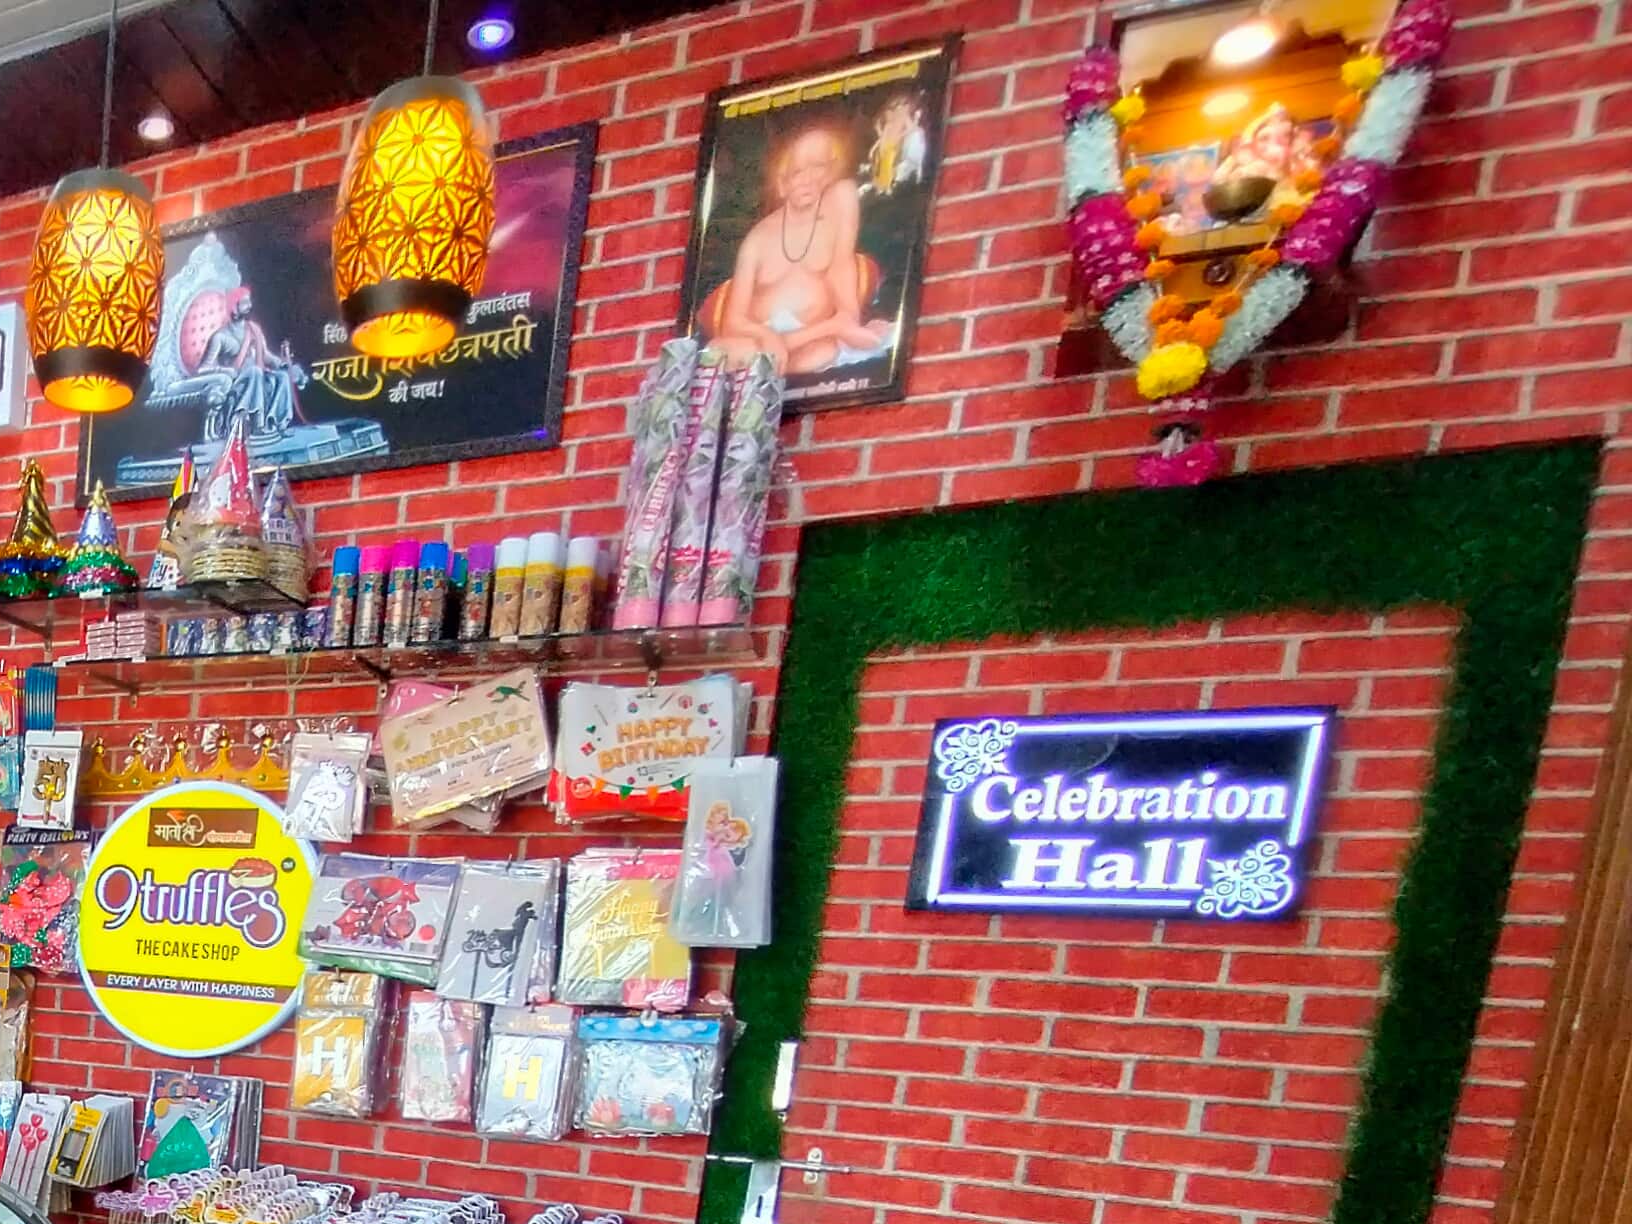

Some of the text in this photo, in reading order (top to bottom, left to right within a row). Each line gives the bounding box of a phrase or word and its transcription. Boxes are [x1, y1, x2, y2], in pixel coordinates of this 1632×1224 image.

[388, 380, 408, 403] की
[617, 716, 693, 741] HAPPY
[598, 736, 710, 773] BIRTHDAY
[971, 771, 1287, 821] Celebration
[6, 831, 37, 843] PARTY
[1001, 837, 1207, 890] Hall
[107, 974, 275, 999] EVERY LAYER WITH HAPPINESS
[310, 1035, 348, 1088] H
[502, 1055, 543, 1101] H
